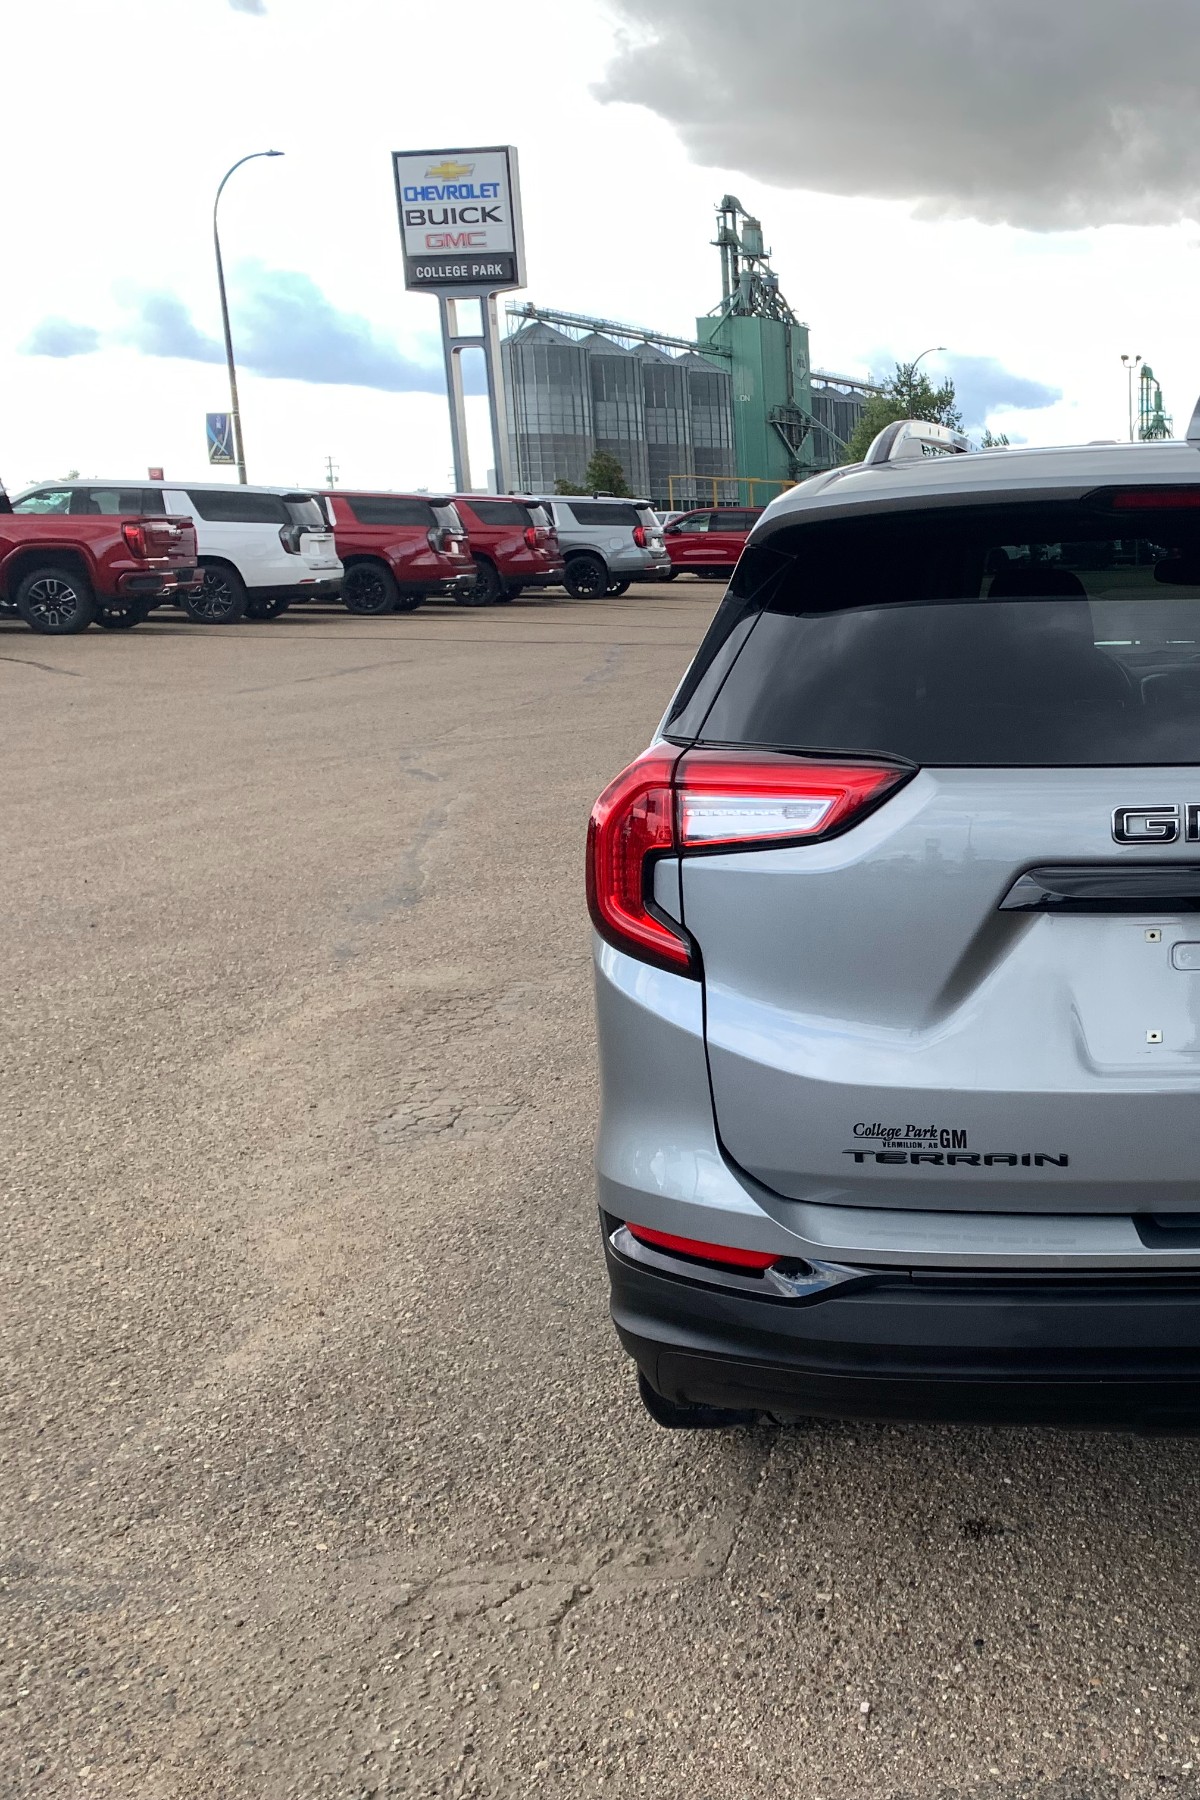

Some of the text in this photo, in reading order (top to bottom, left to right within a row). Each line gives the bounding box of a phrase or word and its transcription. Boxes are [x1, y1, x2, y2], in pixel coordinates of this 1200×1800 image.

[403, 183, 500, 202] CHEVROLET
[405, 206, 504, 227] BUICK
[425, 231, 487, 250] GMC
[416, 264, 503, 278] COLLEGE PARK
[853, 1122, 968, 1149] College Park GM
[841, 1149, 1069, 1167] TERRAIN
